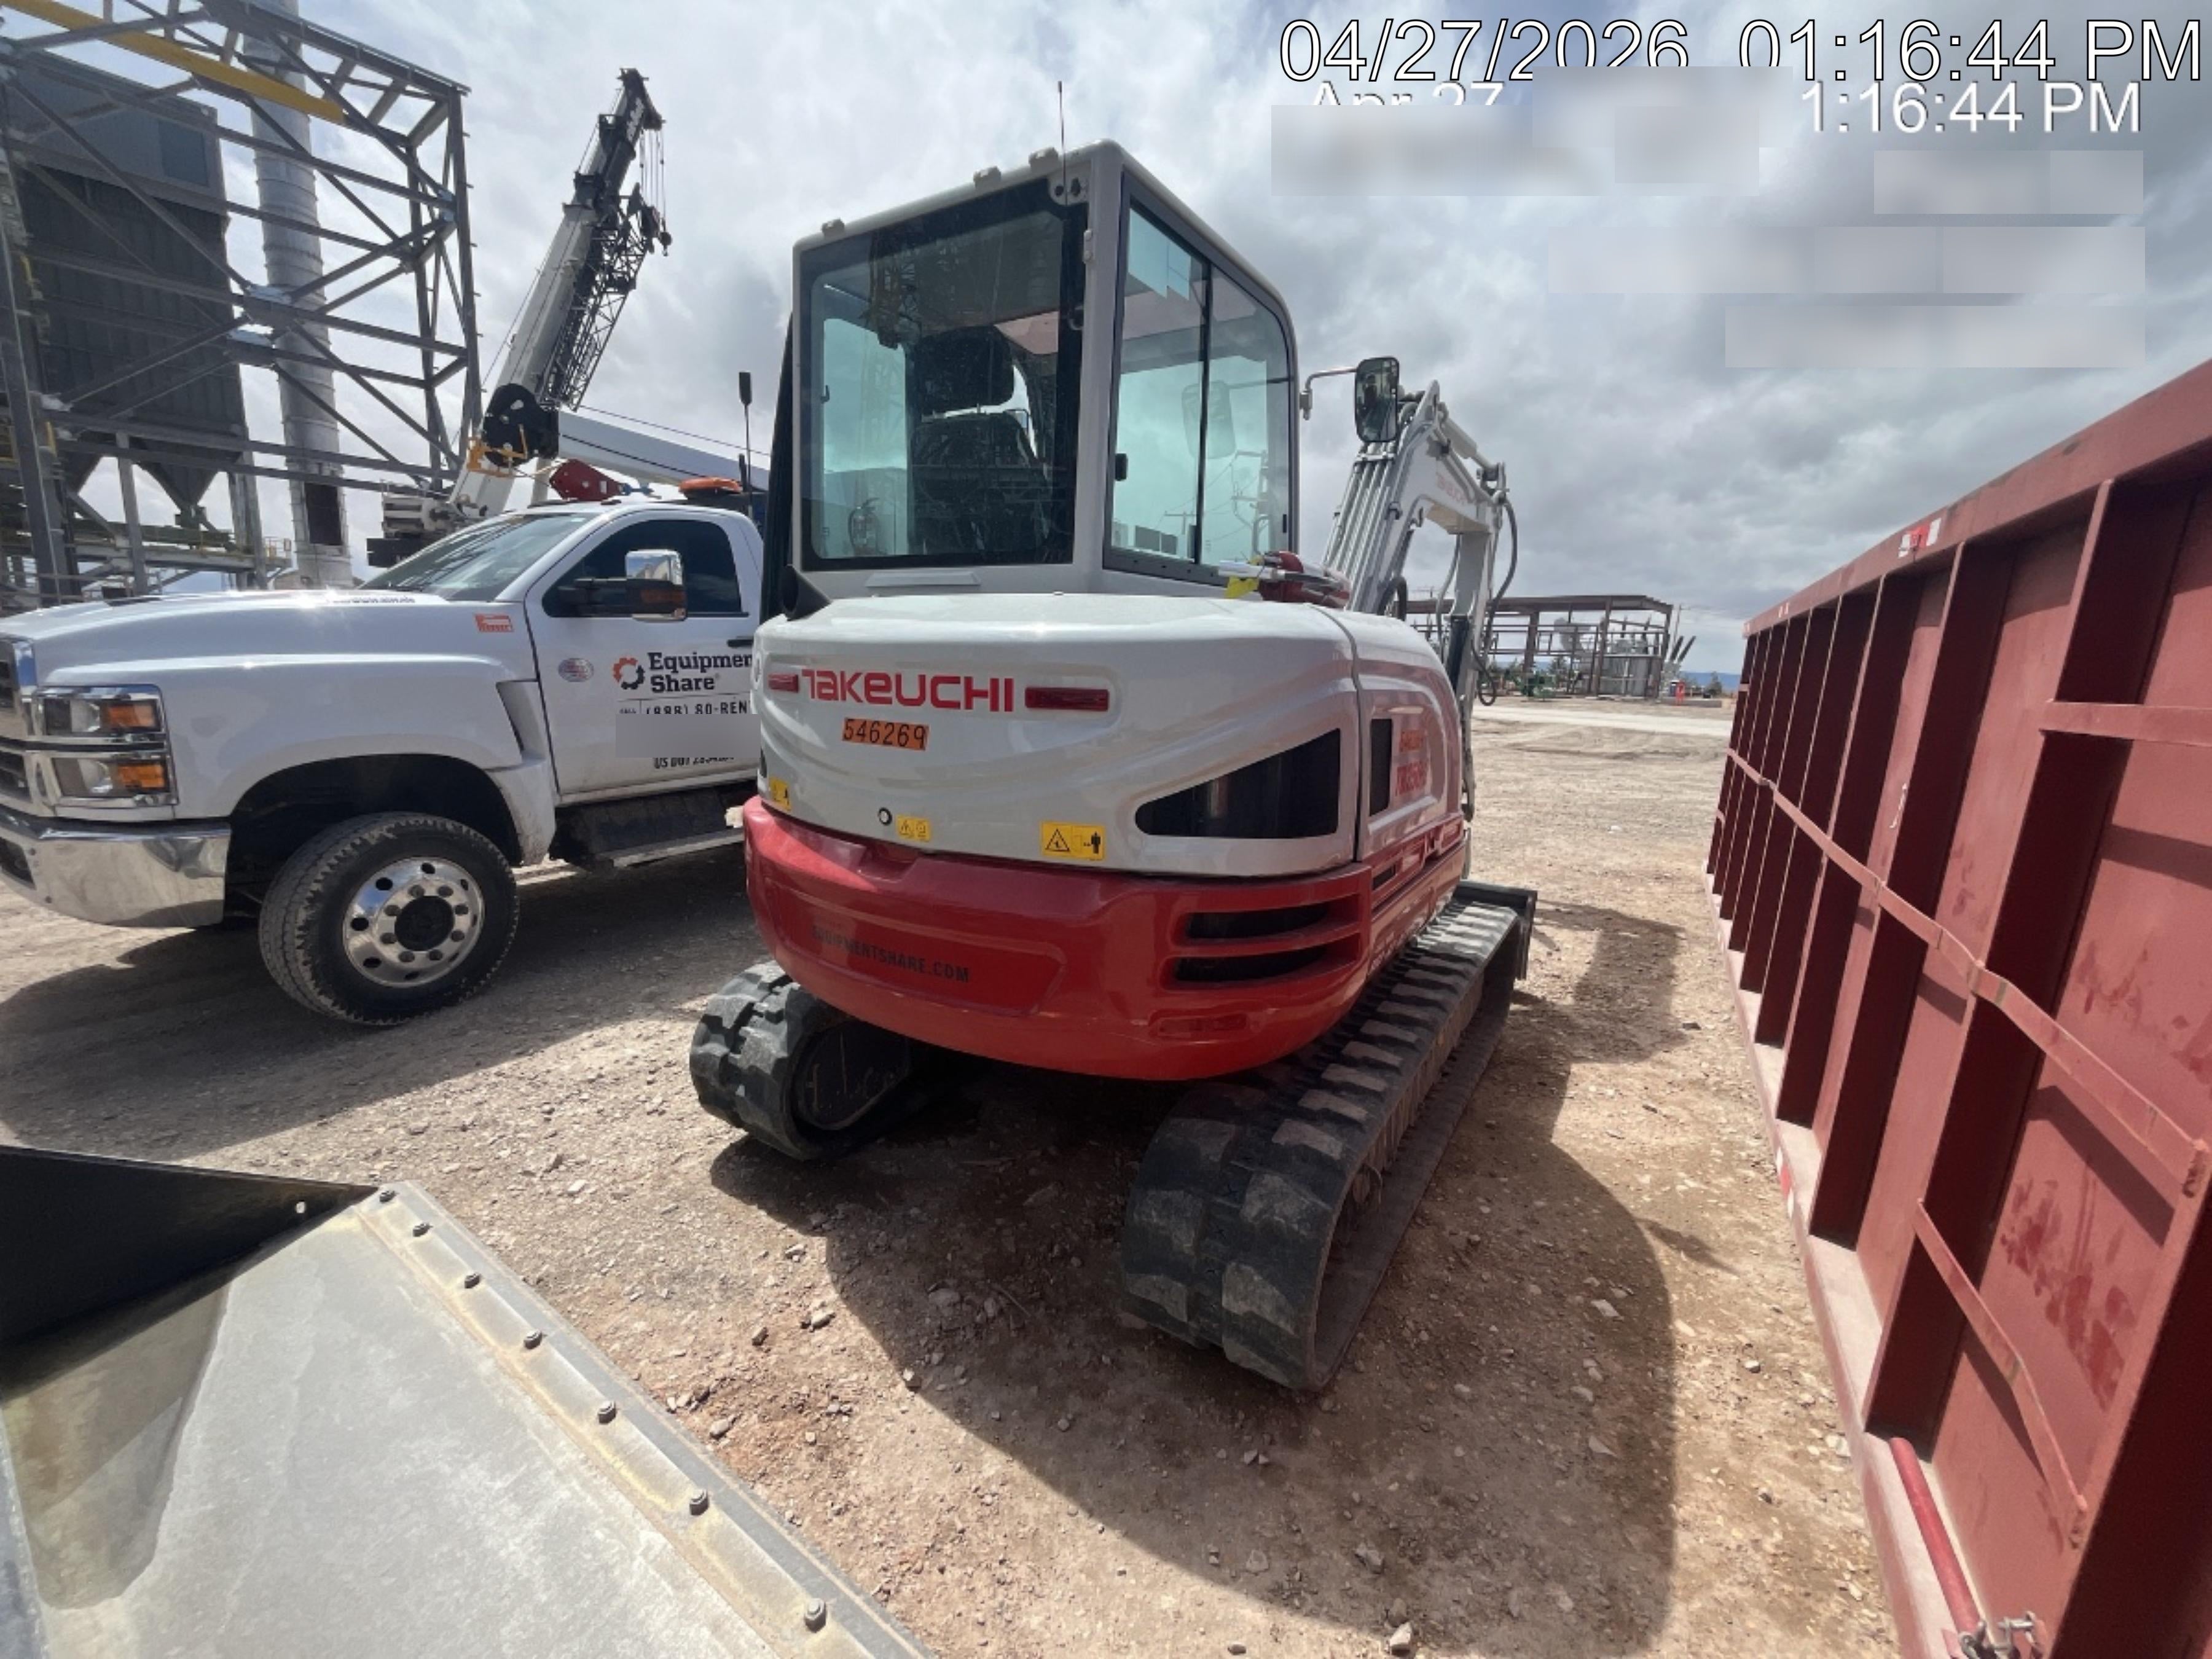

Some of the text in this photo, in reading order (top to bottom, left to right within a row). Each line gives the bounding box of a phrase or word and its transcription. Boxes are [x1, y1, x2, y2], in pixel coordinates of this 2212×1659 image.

[647, 651, 752, 673] Equipmen
[650, 675, 715, 693] Share
[694, 699, 751, 714] 80-REN
[844, 719, 926, 749] 546269
